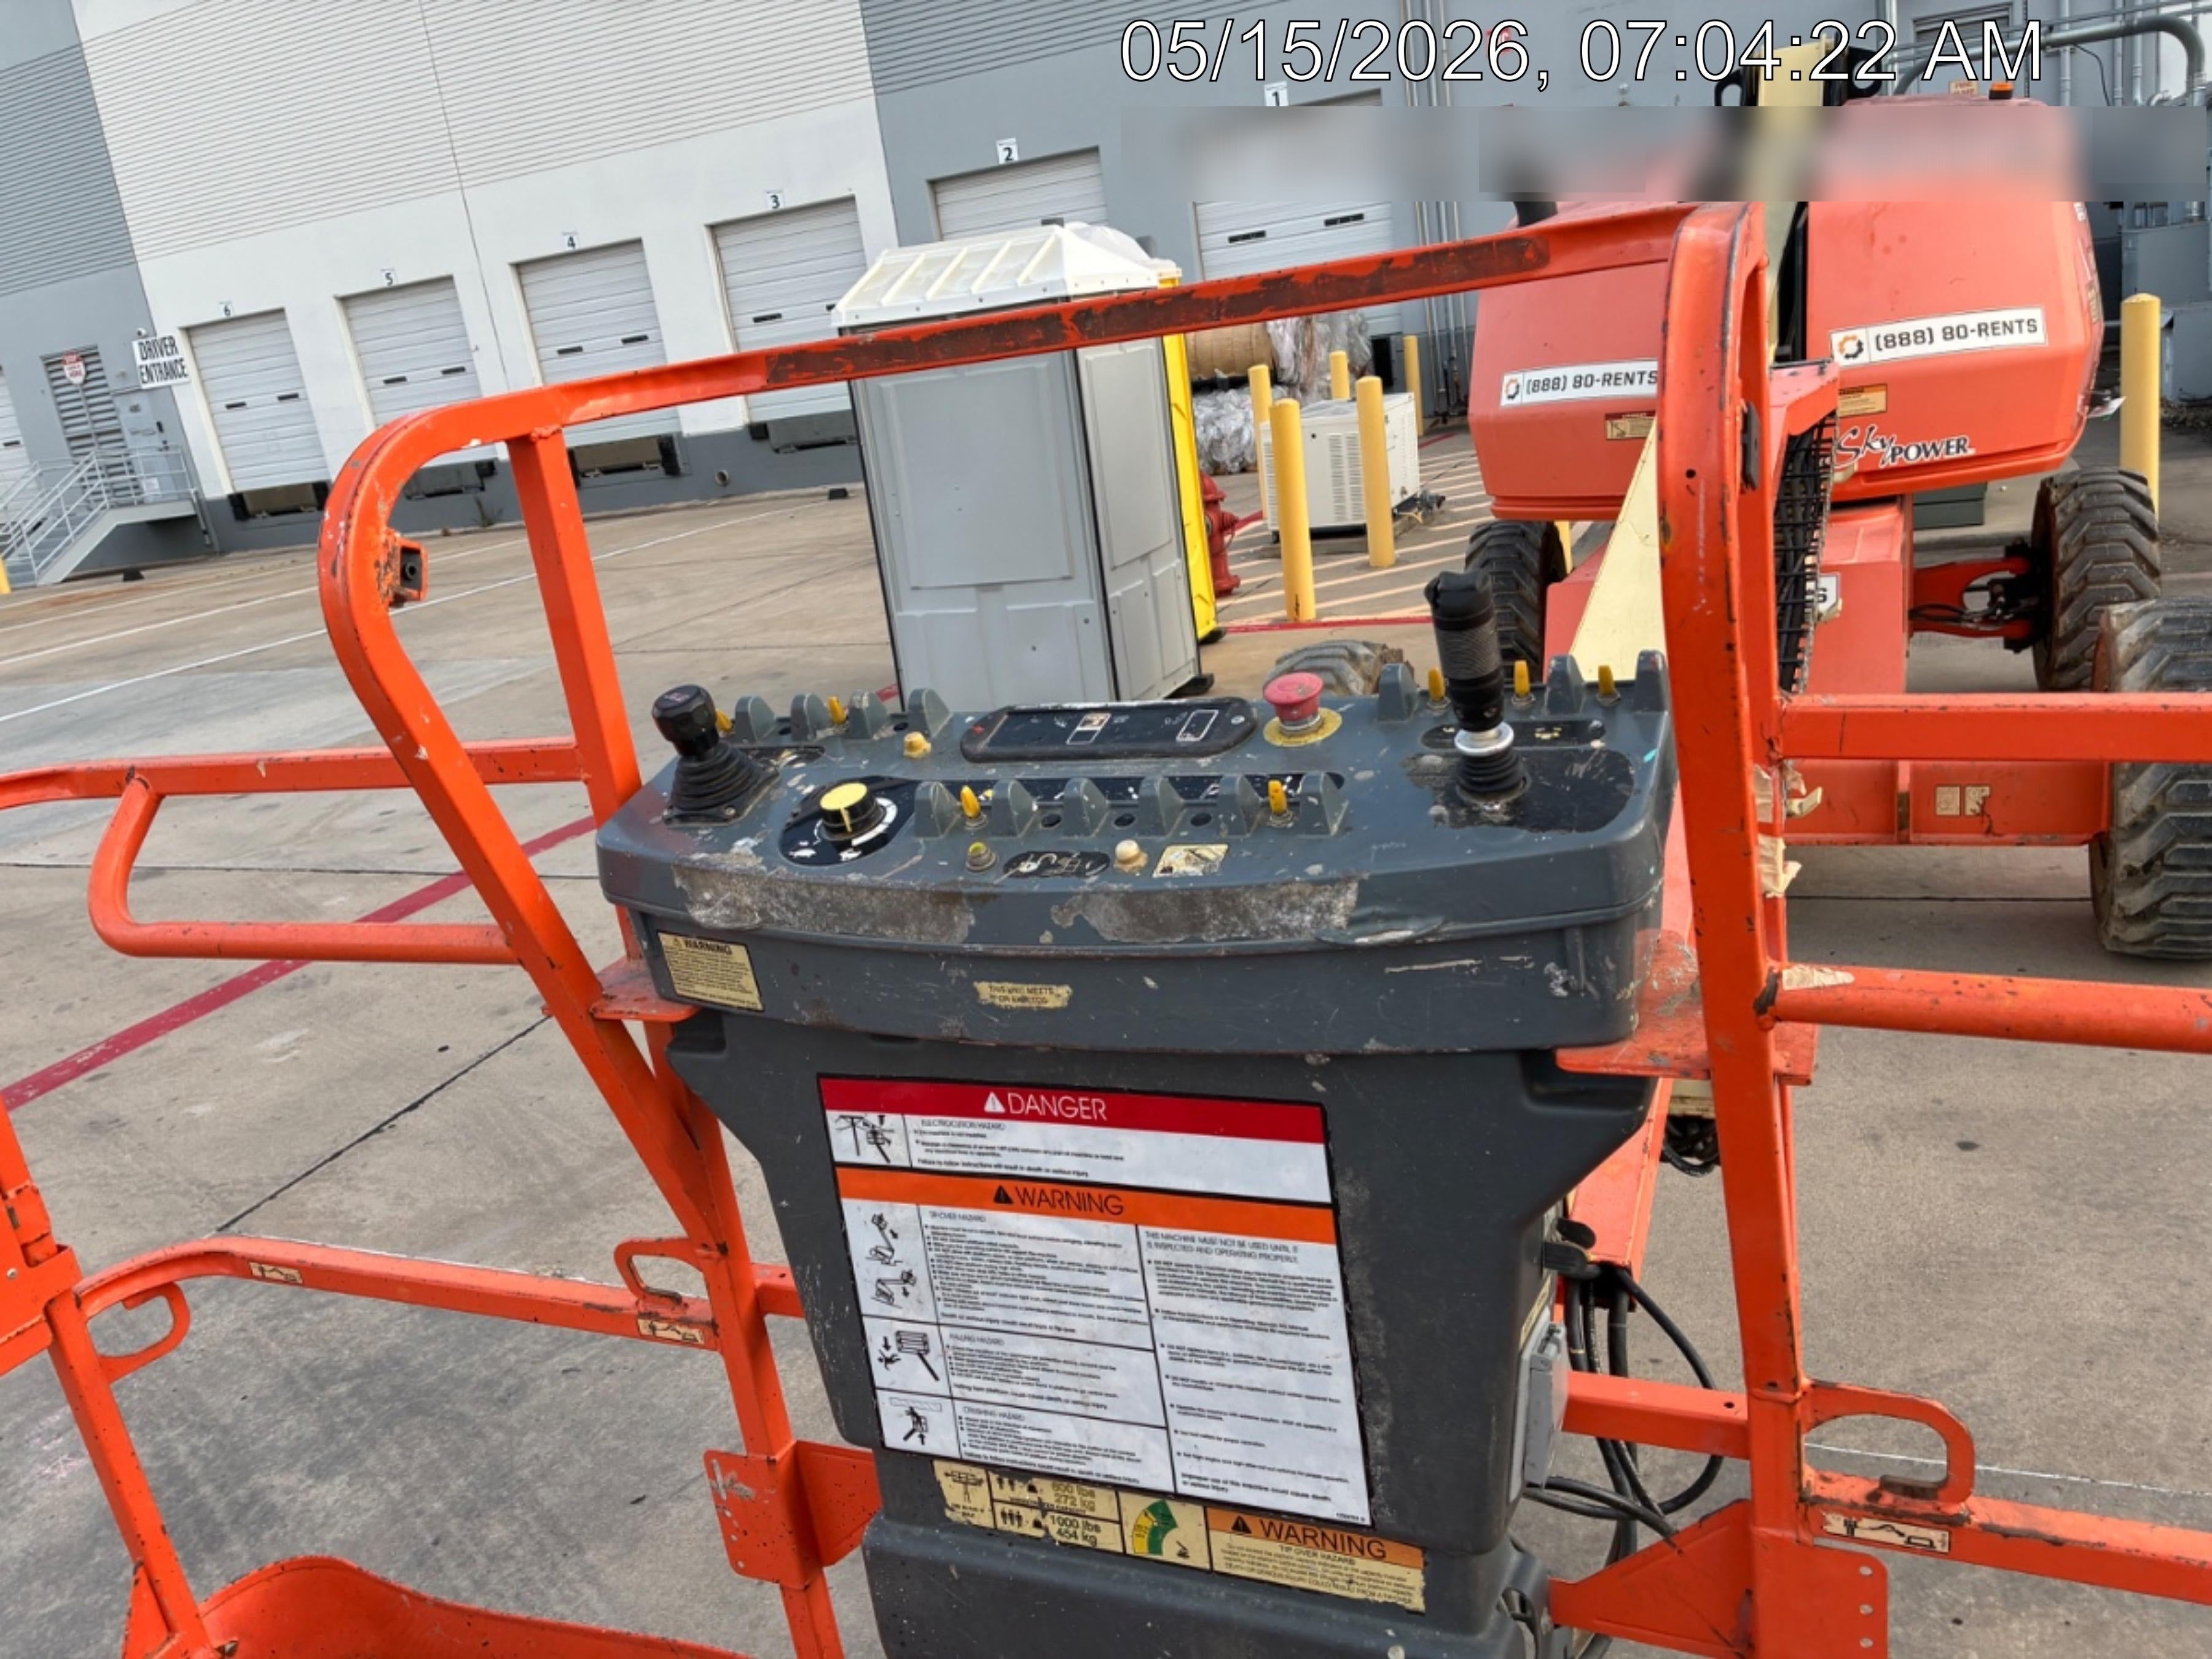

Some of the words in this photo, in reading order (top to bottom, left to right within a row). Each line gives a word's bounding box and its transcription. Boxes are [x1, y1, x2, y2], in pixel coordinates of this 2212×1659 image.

[1271, 92, 1280, 106] 1
[1002, 147, 1013, 161] 2
[770, 195, 780, 209] 3
[567, 235, 576, 250] 4
[385, 272, 393, 286] 5
[223, 305, 231, 316] 6
[138, 336, 179, 361] DRIVER
[1876, 327, 1934, 351] (888)
[139, 358, 188, 383] ENTRANCE
[1526, 375, 1567, 394] (888)
[1007, 1092, 1107, 1121] DANGER
[1015, 1186, 1124, 1215] WARNING
[1054, 1494, 1077, 1505] 272
[1080, 1498, 1096, 1512] kg
[1050, 1514, 1079, 1529] 1000
[1081, 1520, 1102, 1534] lbs
[1056, 1528, 1078, 1540] 454
[1081, 1531, 1097, 1547] kg
[1260, 1518, 1387, 1560] WARNING
